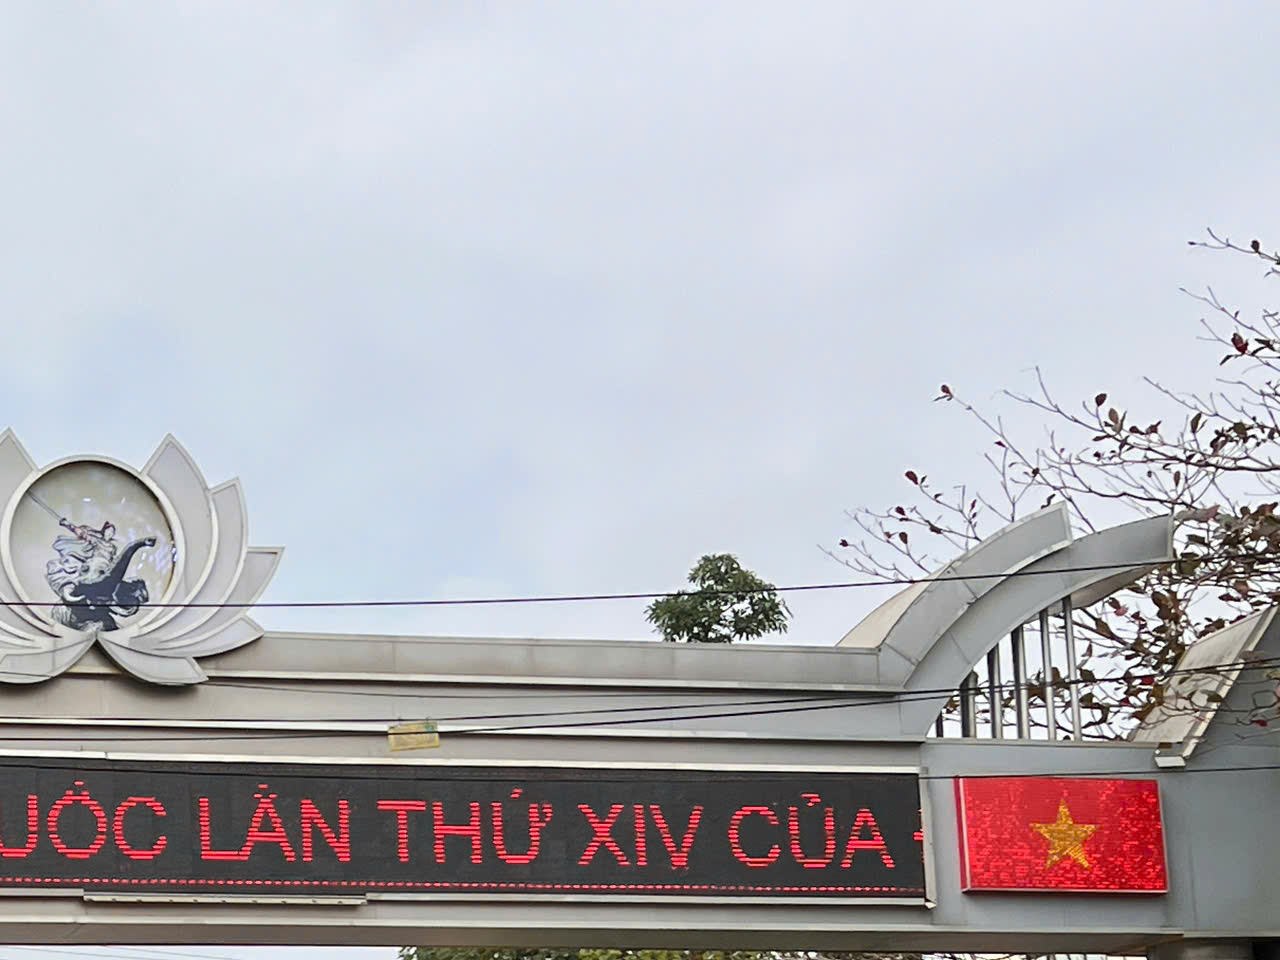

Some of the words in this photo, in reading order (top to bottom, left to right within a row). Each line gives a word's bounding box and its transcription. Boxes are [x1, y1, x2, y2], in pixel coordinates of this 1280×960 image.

[376, 787, 553, 865] THỨ
[577, 803, 705, 867] XIV
[727, 793, 896, 868] CỦA
